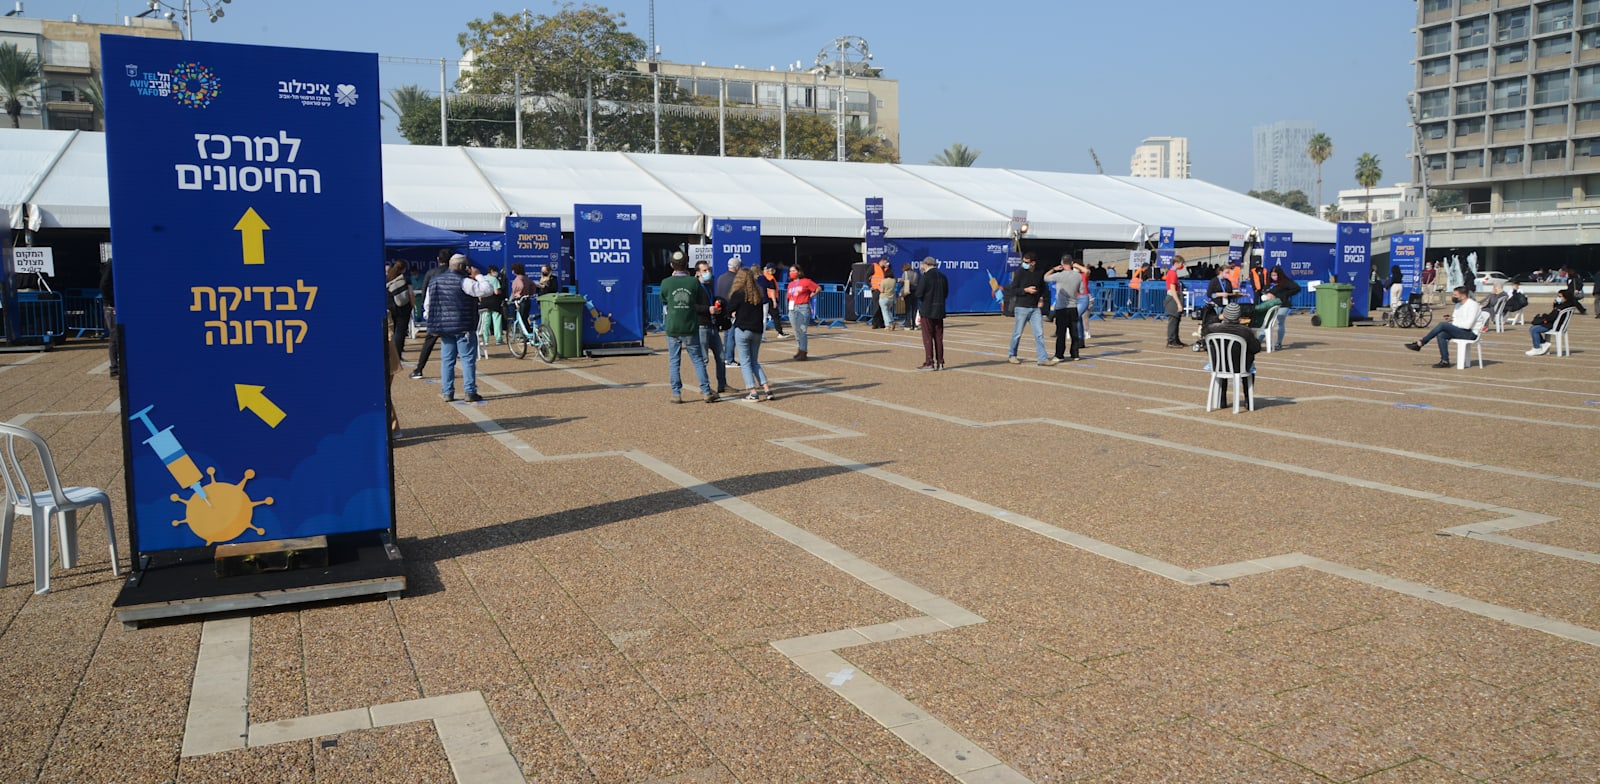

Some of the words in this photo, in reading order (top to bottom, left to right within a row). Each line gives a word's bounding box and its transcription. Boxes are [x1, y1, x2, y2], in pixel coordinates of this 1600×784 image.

[143, 73, 158, 81] TEL
[157, 72, 170, 81] תל
[278, 79, 330, 95] איכילוב
[138, 88, 158, 96] YAFO
[158, 88, 171, 96] יפו
[194, 130, 301, 163] למרכז
[175, 164, 321, 193] החיסונים
[518, 233, 548, 241] הבריאות
[517, 241, 532, 249] הכל
[533, 241, 549, 250] מעל
[589, 238, 631, 250] ברוכים
[723, 244, 751, 253] מתחם
[1344, 245, 1366, 254] ברוכים
[16, 251, 43, 259] המקום
[589, 251, 630, 263] הבאים
[1344, 254, 1365, 263] הבאים
[943, 260, 959, 269] יותר
[959, 260, 979, 269] בטוח
[190, 279, 318, 321] לבדיקת
[204, 319, 308, 354] קורונה
